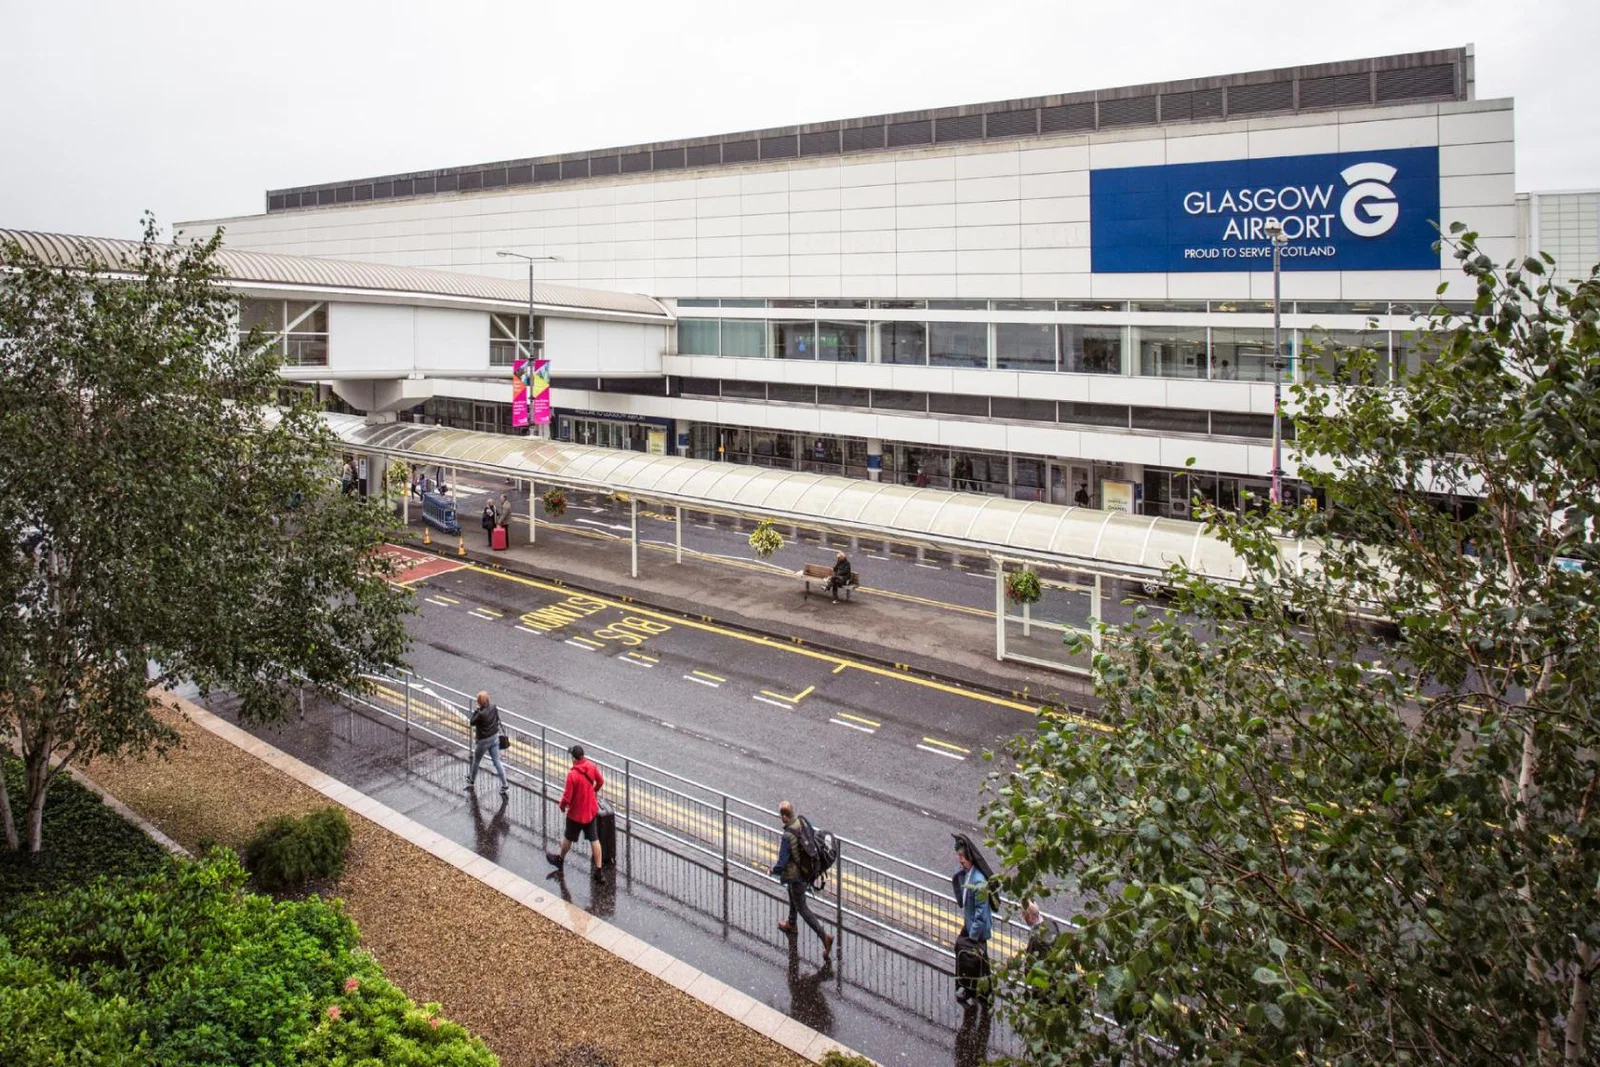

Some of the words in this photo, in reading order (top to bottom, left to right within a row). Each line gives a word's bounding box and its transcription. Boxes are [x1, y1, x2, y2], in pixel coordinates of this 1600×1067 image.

[1183, 184, 1334, 214] GLASGOW
[1184, 248, 1219, 259] PROUD
[1222, 247, 1237, 258] TO
[1239, 246, 1271, 258] SERVE
[1273, 245, 1336, 257] COTLAND
[519, 597, 608, 632] STAND
[593, 616, 672, 646] BUS
